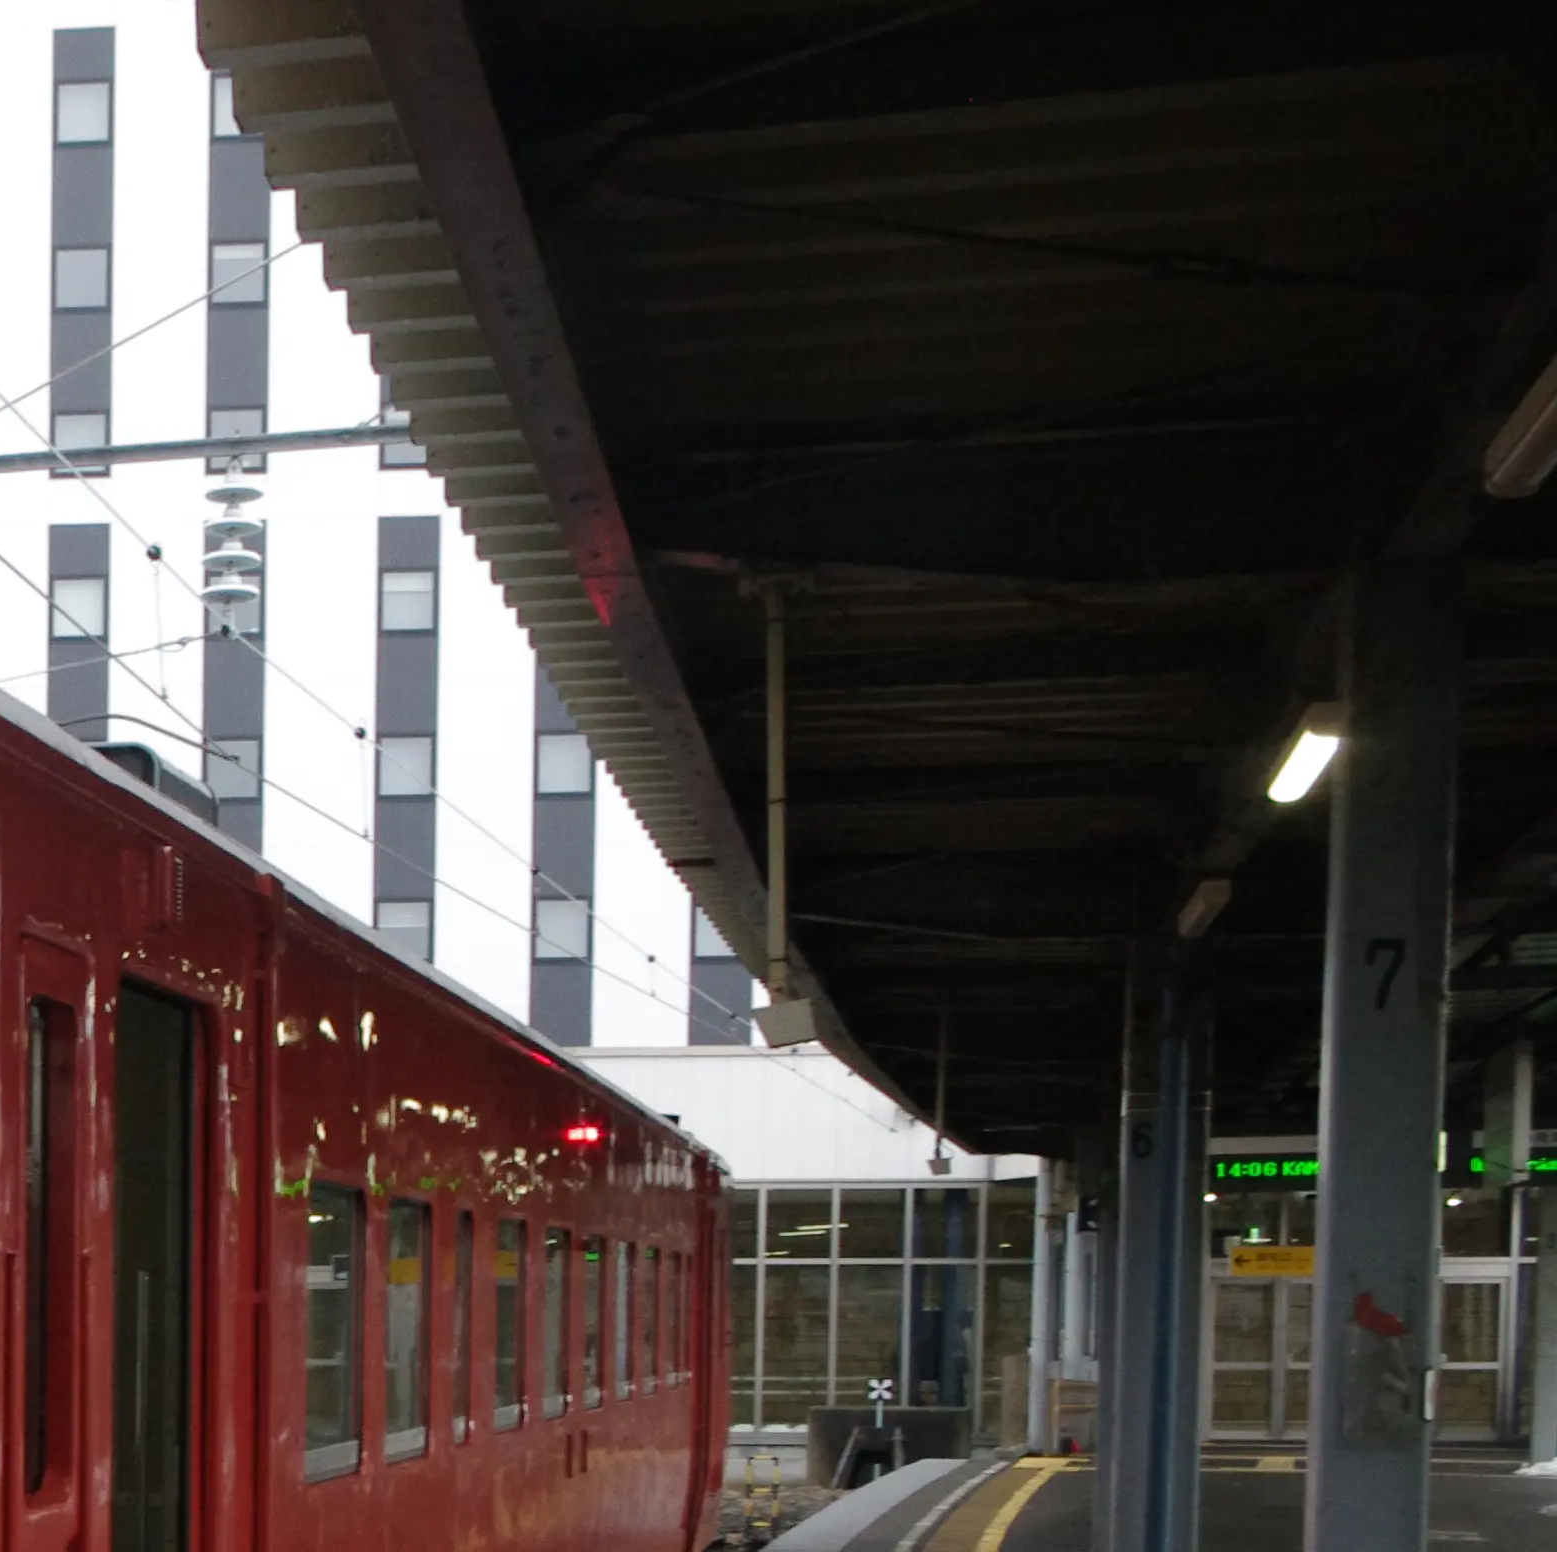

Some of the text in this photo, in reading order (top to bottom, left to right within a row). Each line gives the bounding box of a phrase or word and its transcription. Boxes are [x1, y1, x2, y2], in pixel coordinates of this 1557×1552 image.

[1365, 937, 1407, 1010] 7
[1132, 1121, 1154, 1160] 6
[1216, 1162, 1278, 1178] 14:06
